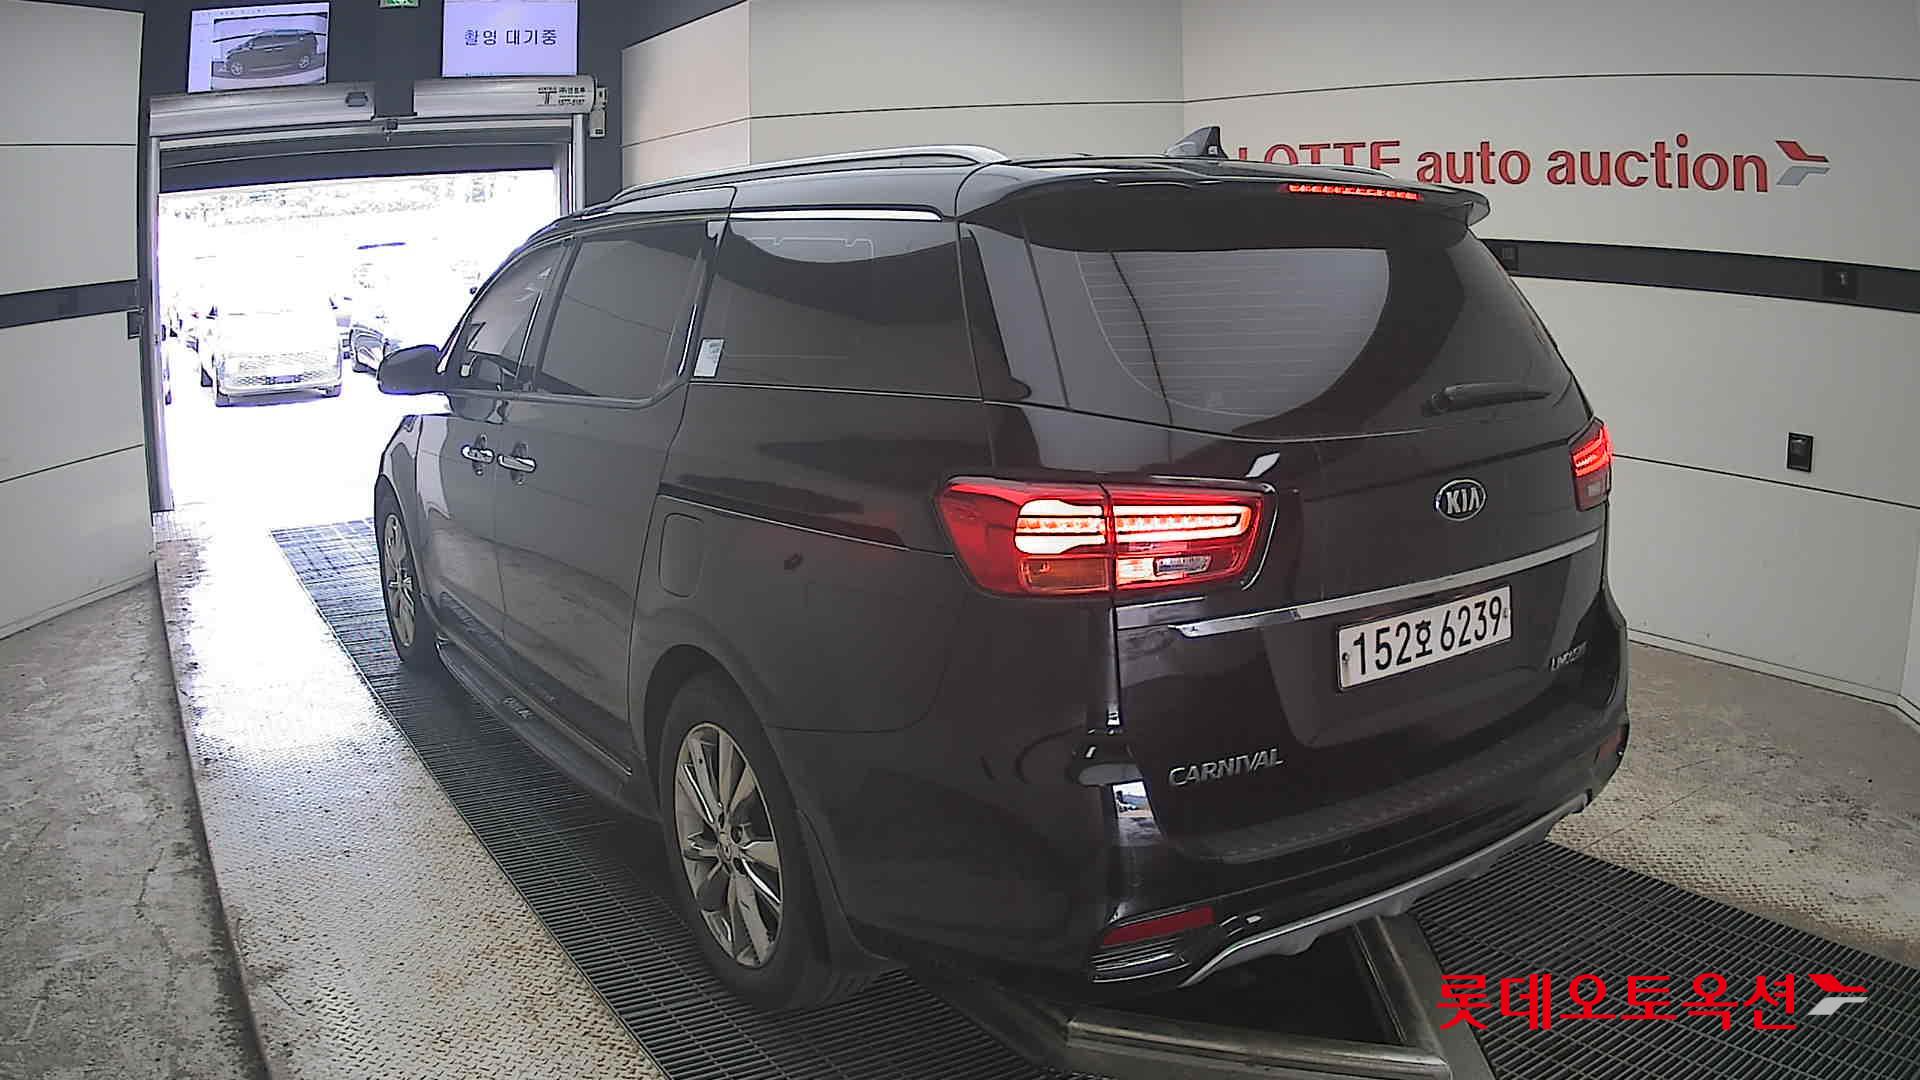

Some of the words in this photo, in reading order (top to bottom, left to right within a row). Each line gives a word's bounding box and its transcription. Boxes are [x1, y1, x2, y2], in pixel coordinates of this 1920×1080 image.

[505, 29, 557, 46] 대기중
[1416, 141, 1531, 185] auto
[1546, 133, 1769, 193] auction
[1446, 487, 1480, 514] KIA
[1168, 748, 1284, 786] CARNIVAL
